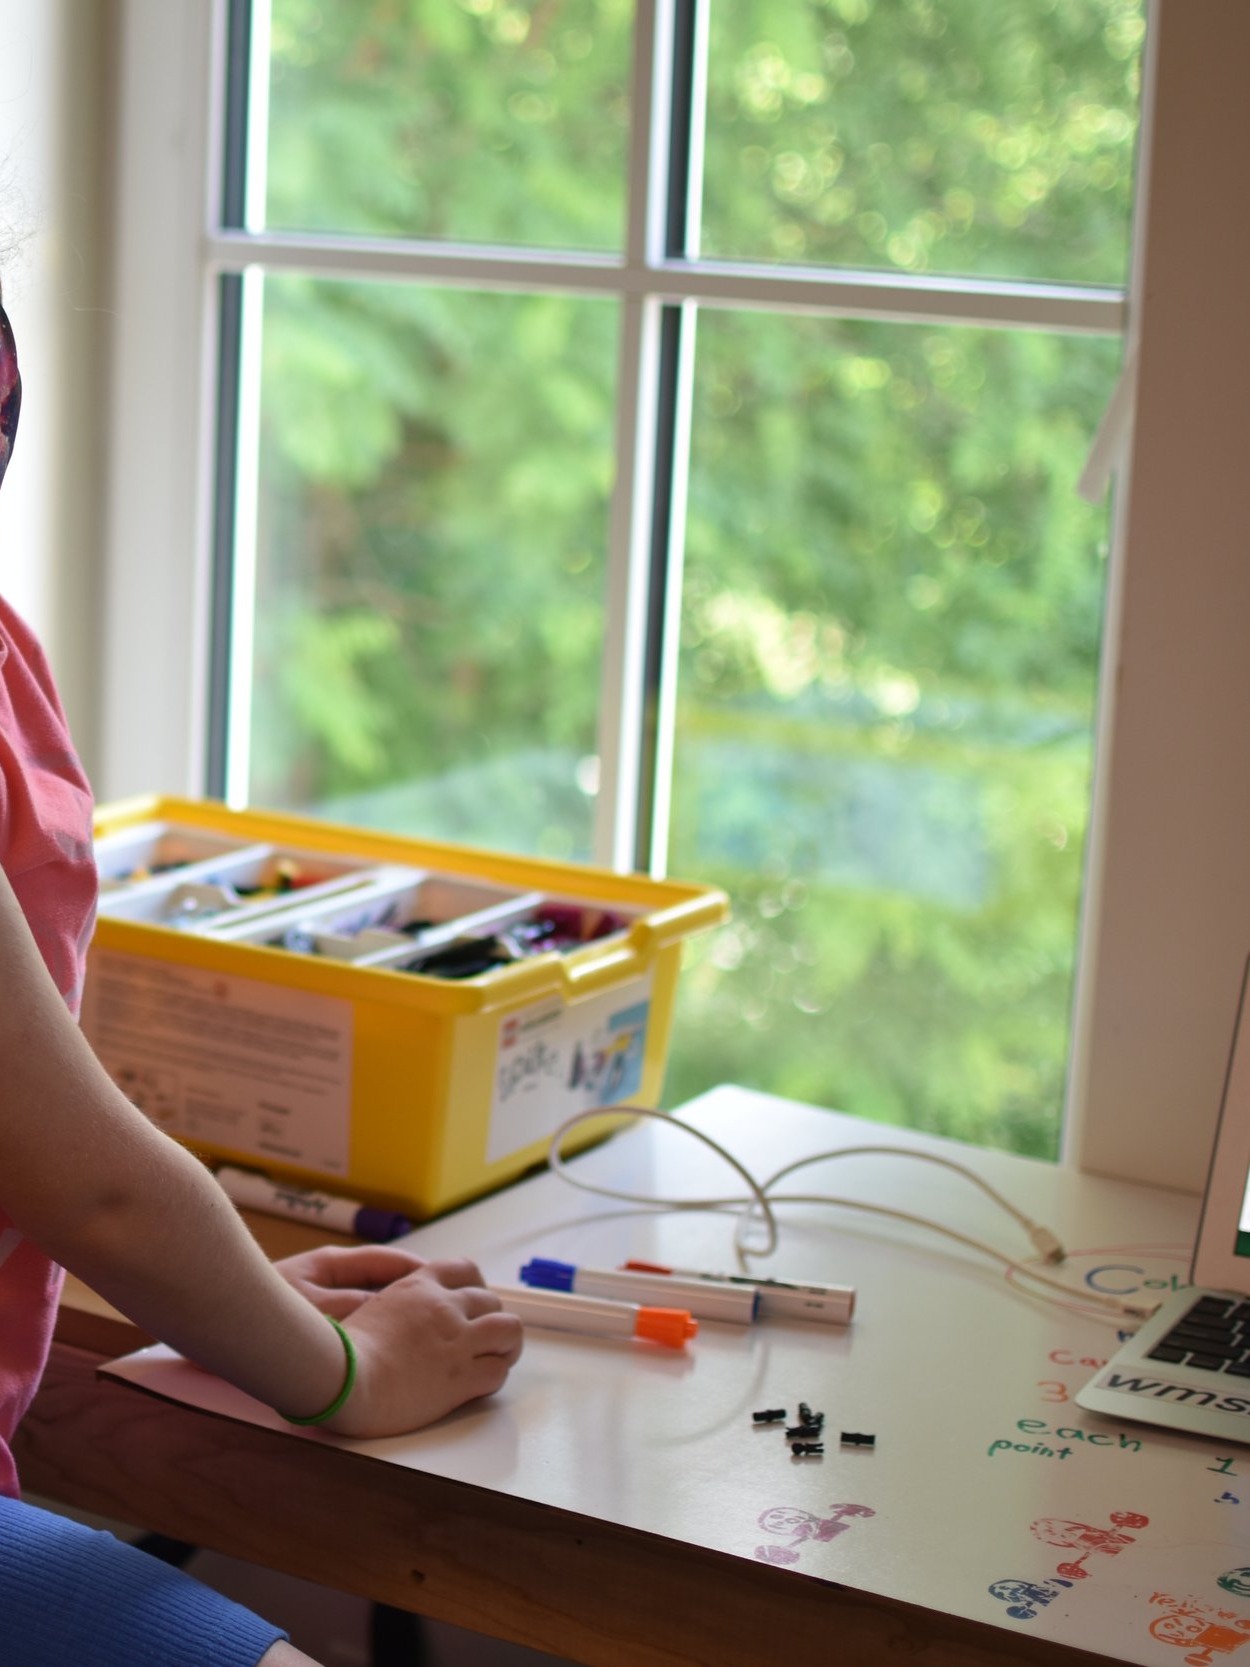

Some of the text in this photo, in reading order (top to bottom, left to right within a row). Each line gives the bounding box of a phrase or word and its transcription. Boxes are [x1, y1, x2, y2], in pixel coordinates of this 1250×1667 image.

[1107, 1373, 1250, 1416] wms
[987, 1439, 1073, 1460] point
[1016, 1419, 1142, 1452] each
